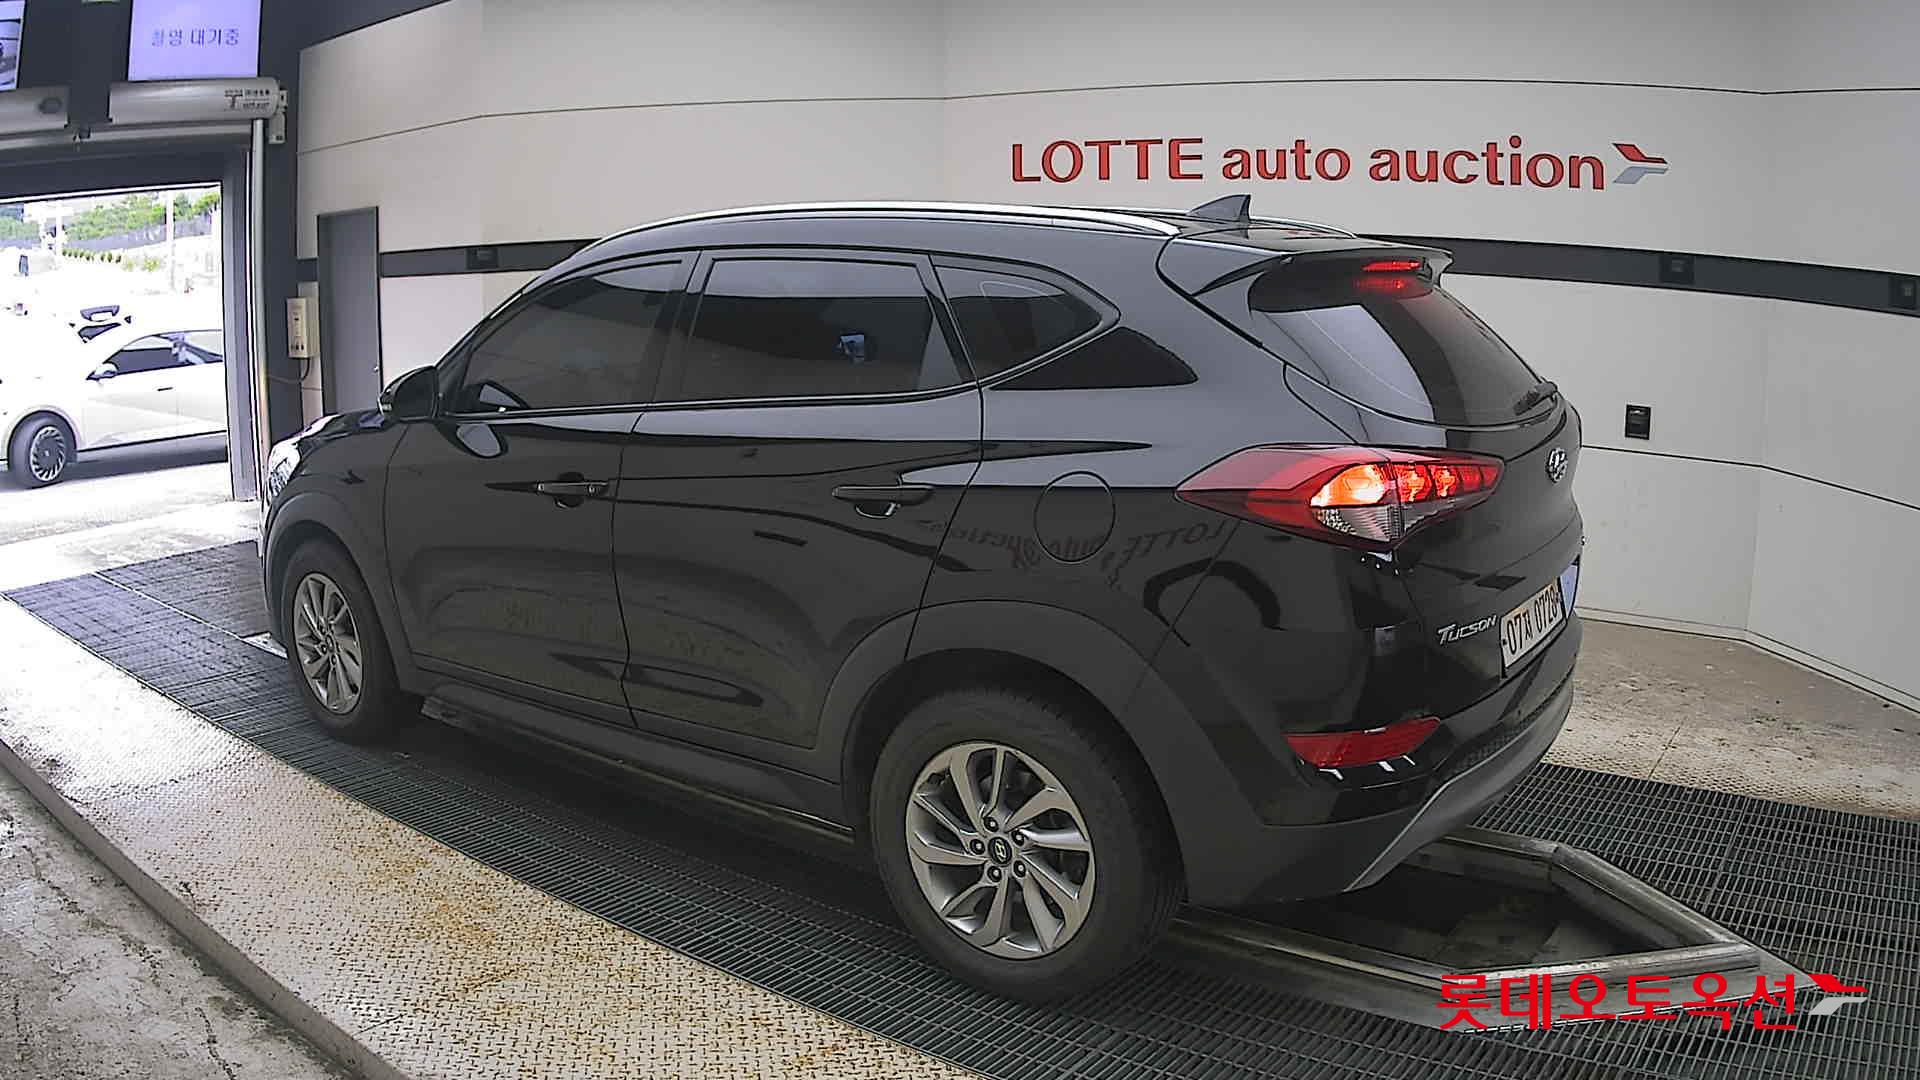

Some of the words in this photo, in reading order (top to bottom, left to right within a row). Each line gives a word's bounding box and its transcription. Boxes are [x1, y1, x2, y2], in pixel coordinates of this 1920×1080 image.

[190, 27, 240, 47] 대기중
[1011, 137, 1204, 183] LOTTE
[1221, 138, 1352, 182] auto
[1368, 135, 1606, 191] auction
